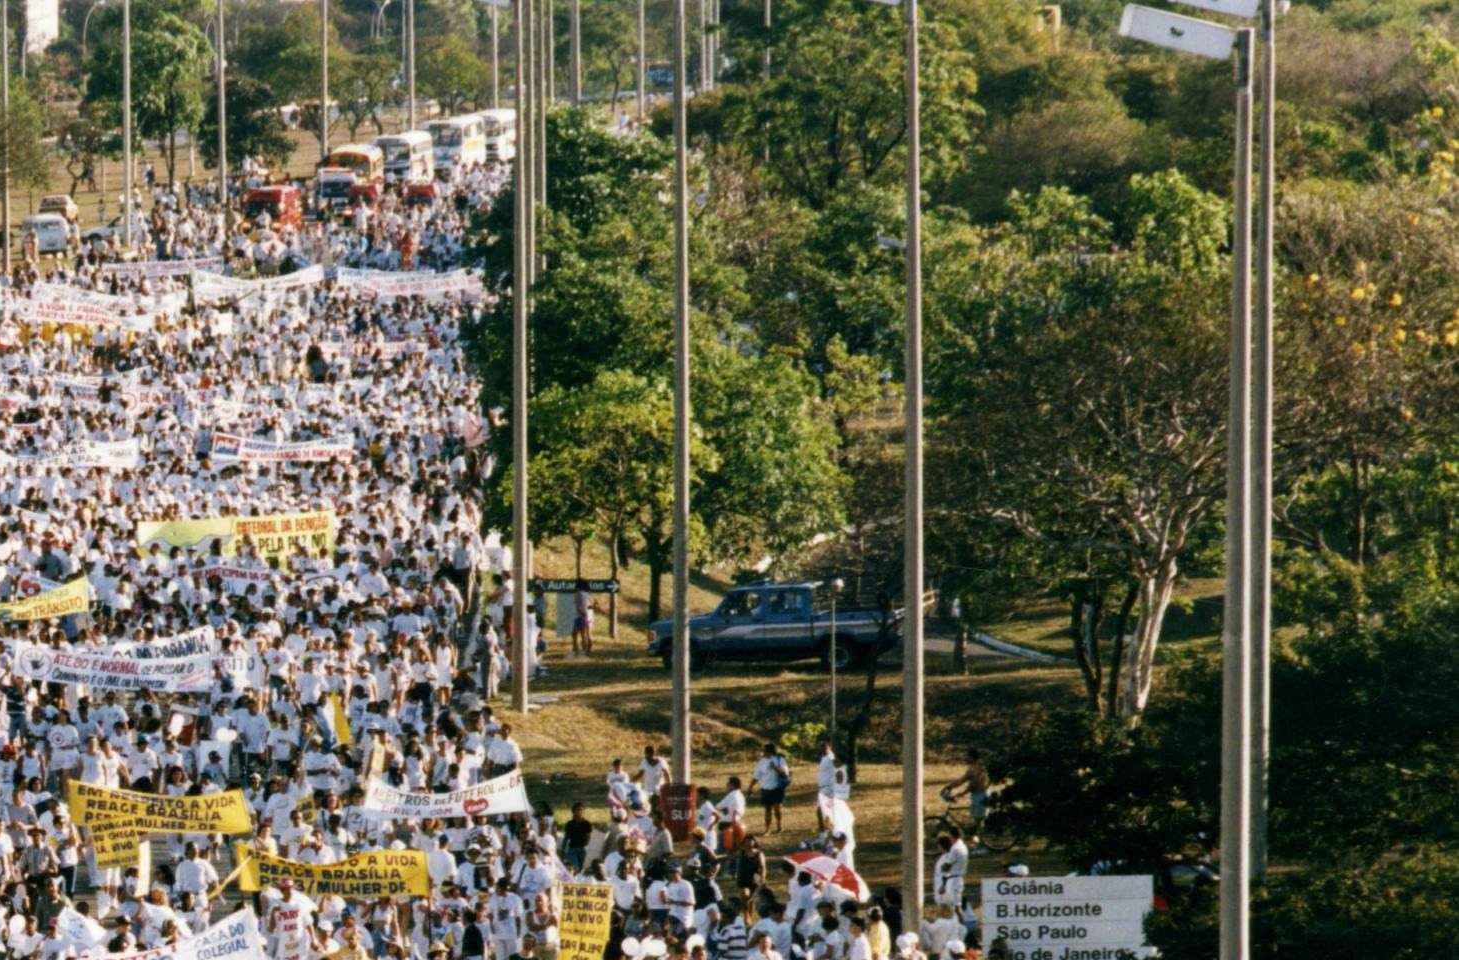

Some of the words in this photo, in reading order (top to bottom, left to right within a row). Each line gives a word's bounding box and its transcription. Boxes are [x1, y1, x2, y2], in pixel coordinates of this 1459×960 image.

[87, 799, 139, 816] REAGE
[204, 795, 238, 810] VIDA
[385, 855, 419, 867] VIDA
[259, 862, 314, 878] REAGE
[996, 881, 1064, 896] Goiânia
[1039, 924, 1087, 940] Paulo
[197, 938, 250, 960] COLEGIAL
